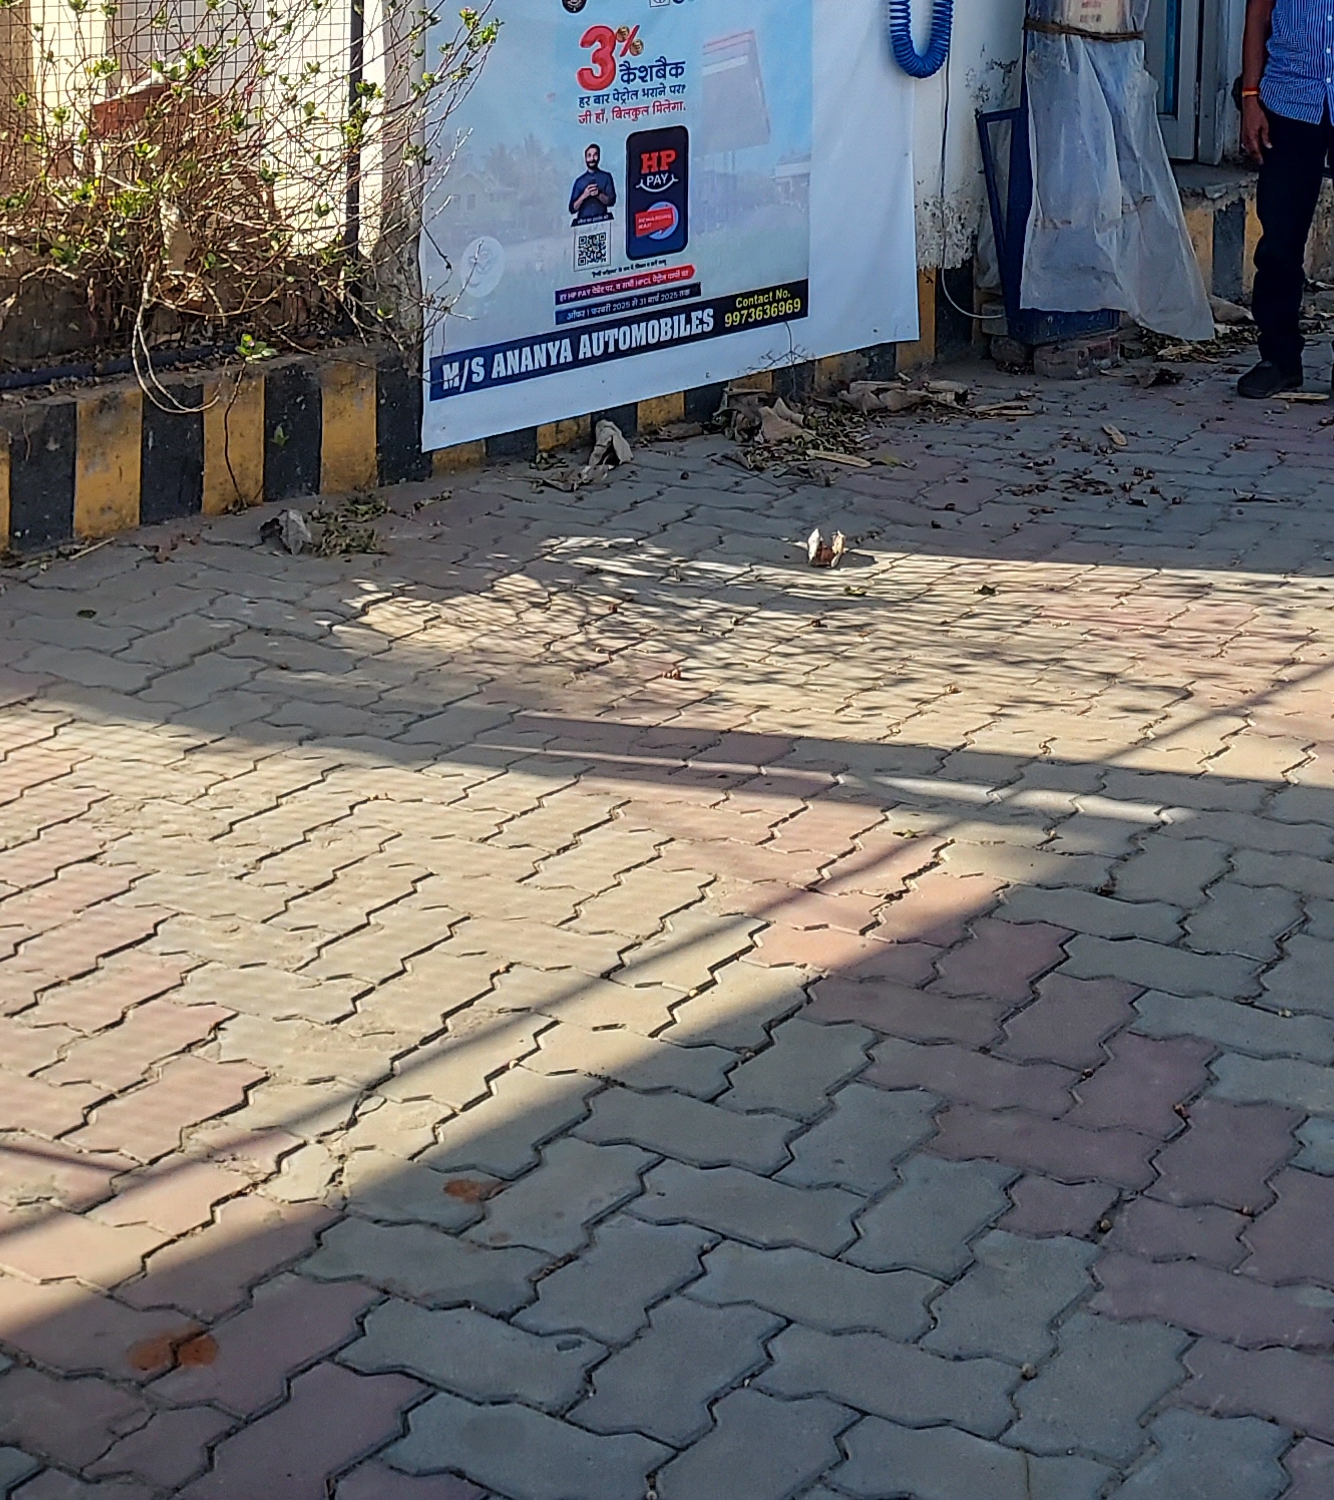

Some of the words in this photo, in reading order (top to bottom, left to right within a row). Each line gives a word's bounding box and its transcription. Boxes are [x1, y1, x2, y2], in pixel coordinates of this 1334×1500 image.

[619, 56, 686, 84] कैशबैक
[578, 95, 590, 108] हर
[612, 87, 639, 105] पेट्रोल
[642, 82, 666, 98] भराने
[578, 109, 592, 125] जी
[640, 149, 677, 175] HP
[646, 173, 669, 187] PAY
[577, 289, 591, 298] PAY
[612, 301, 631, 311] 2025
[639, 297, 646, 306] 31
[660, 291, 678, 301] 2025
[735, 292, 772, 309] Contact
[773, 289, 792, 303] No.
[724, 299, 802, 328] 9973636969
[442, 356, 486, 392] M/S
[491, 338, 573, 380] ANANYA
[578, 308, 715, 361] AUTOMOBILES
